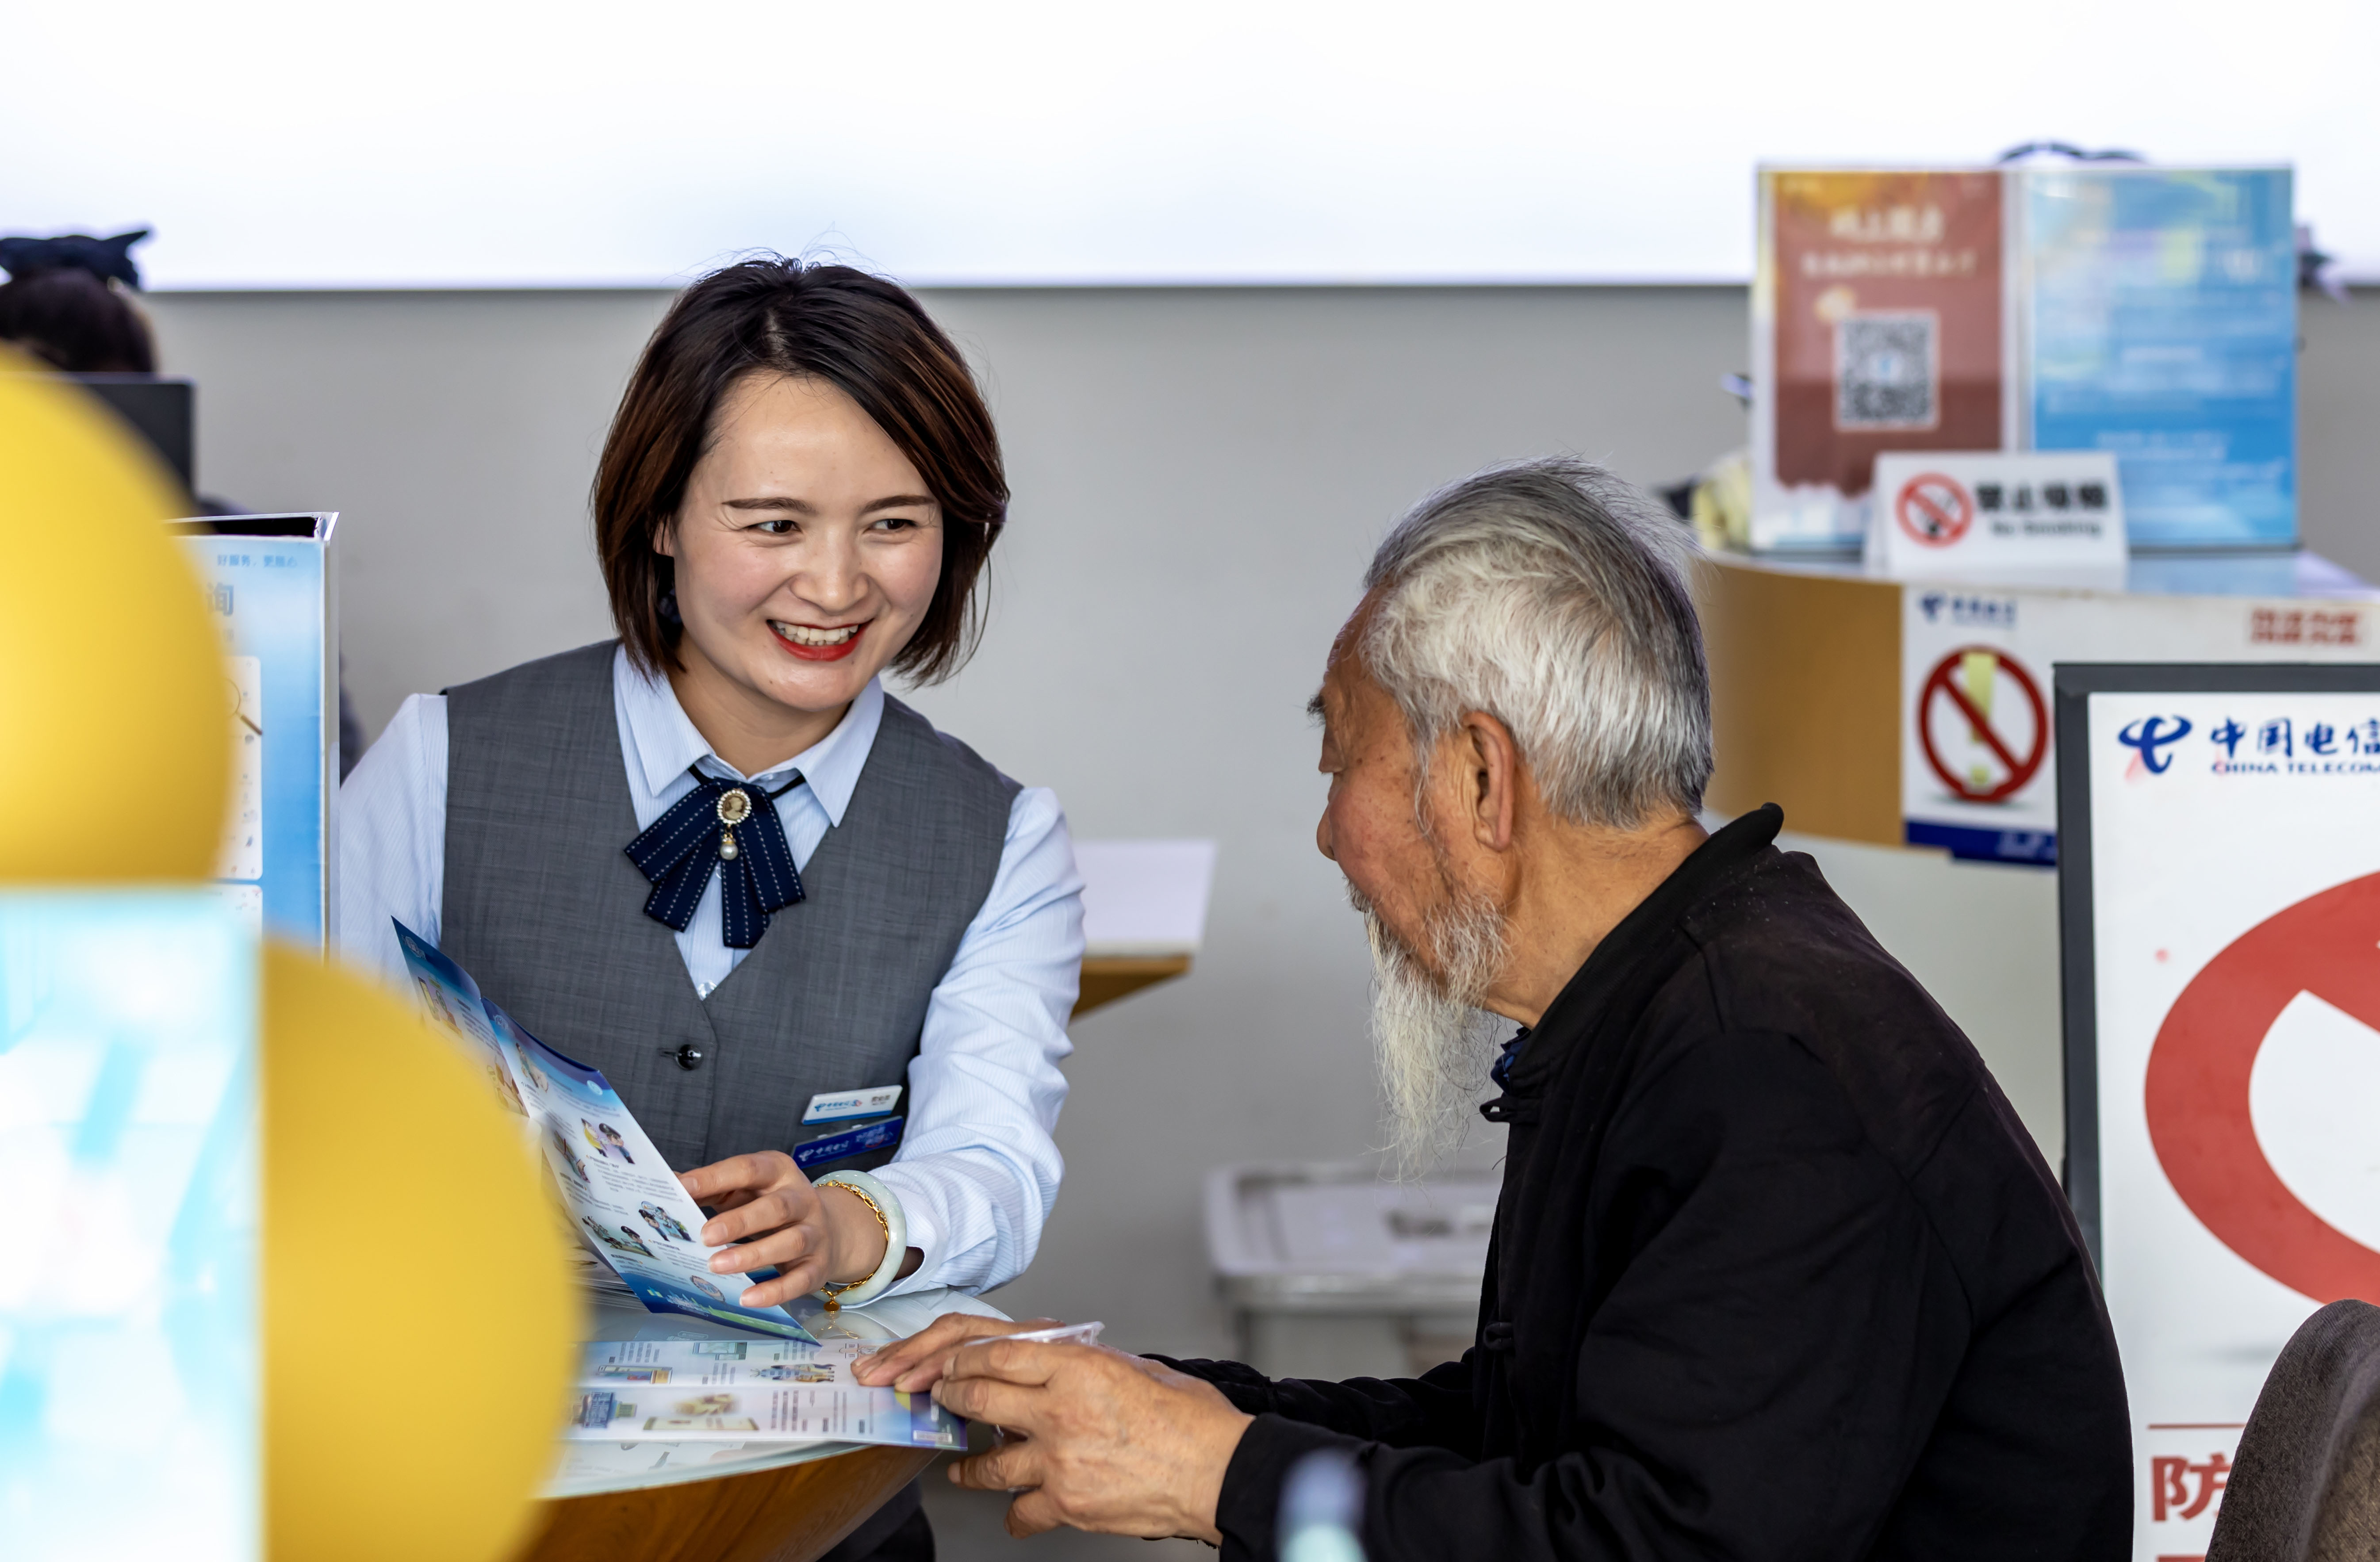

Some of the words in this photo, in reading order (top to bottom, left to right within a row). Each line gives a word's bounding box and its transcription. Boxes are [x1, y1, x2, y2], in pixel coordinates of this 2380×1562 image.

[2211, 716, 2380, 758] 中国电信
[2211, 762, 2279, 774] CHINA
